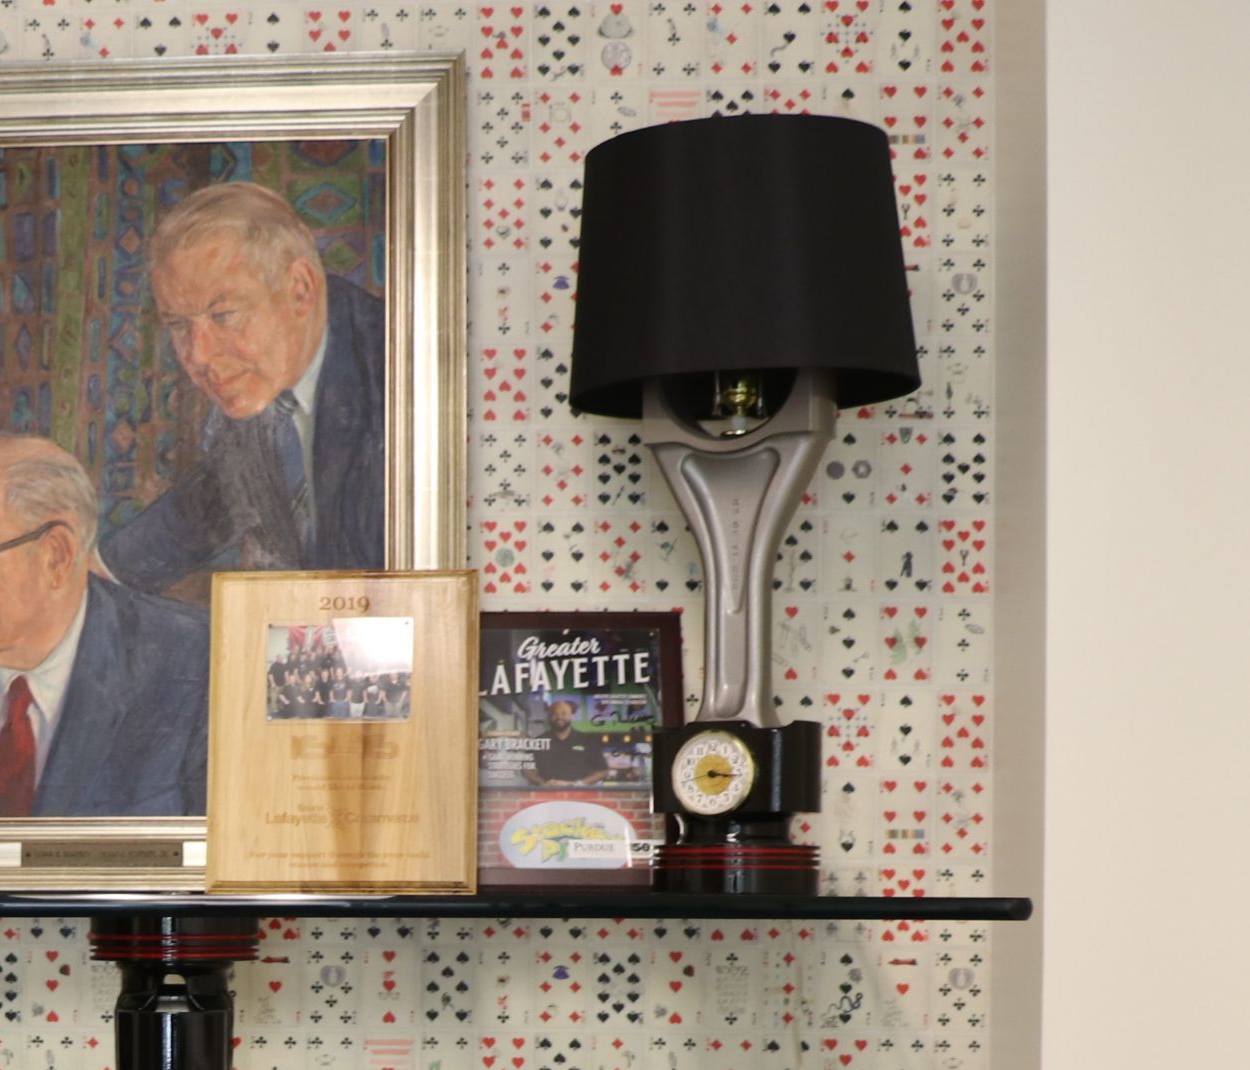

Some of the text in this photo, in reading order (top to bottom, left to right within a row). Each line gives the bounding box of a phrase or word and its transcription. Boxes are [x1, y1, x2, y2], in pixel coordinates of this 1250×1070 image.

[319, 596, 370, 612] 2019
[517, 636, 601, 660] Greater
[478, 652, 650, 697] AFAYETTE
[506, 738, 551, 751] BRACKETT
